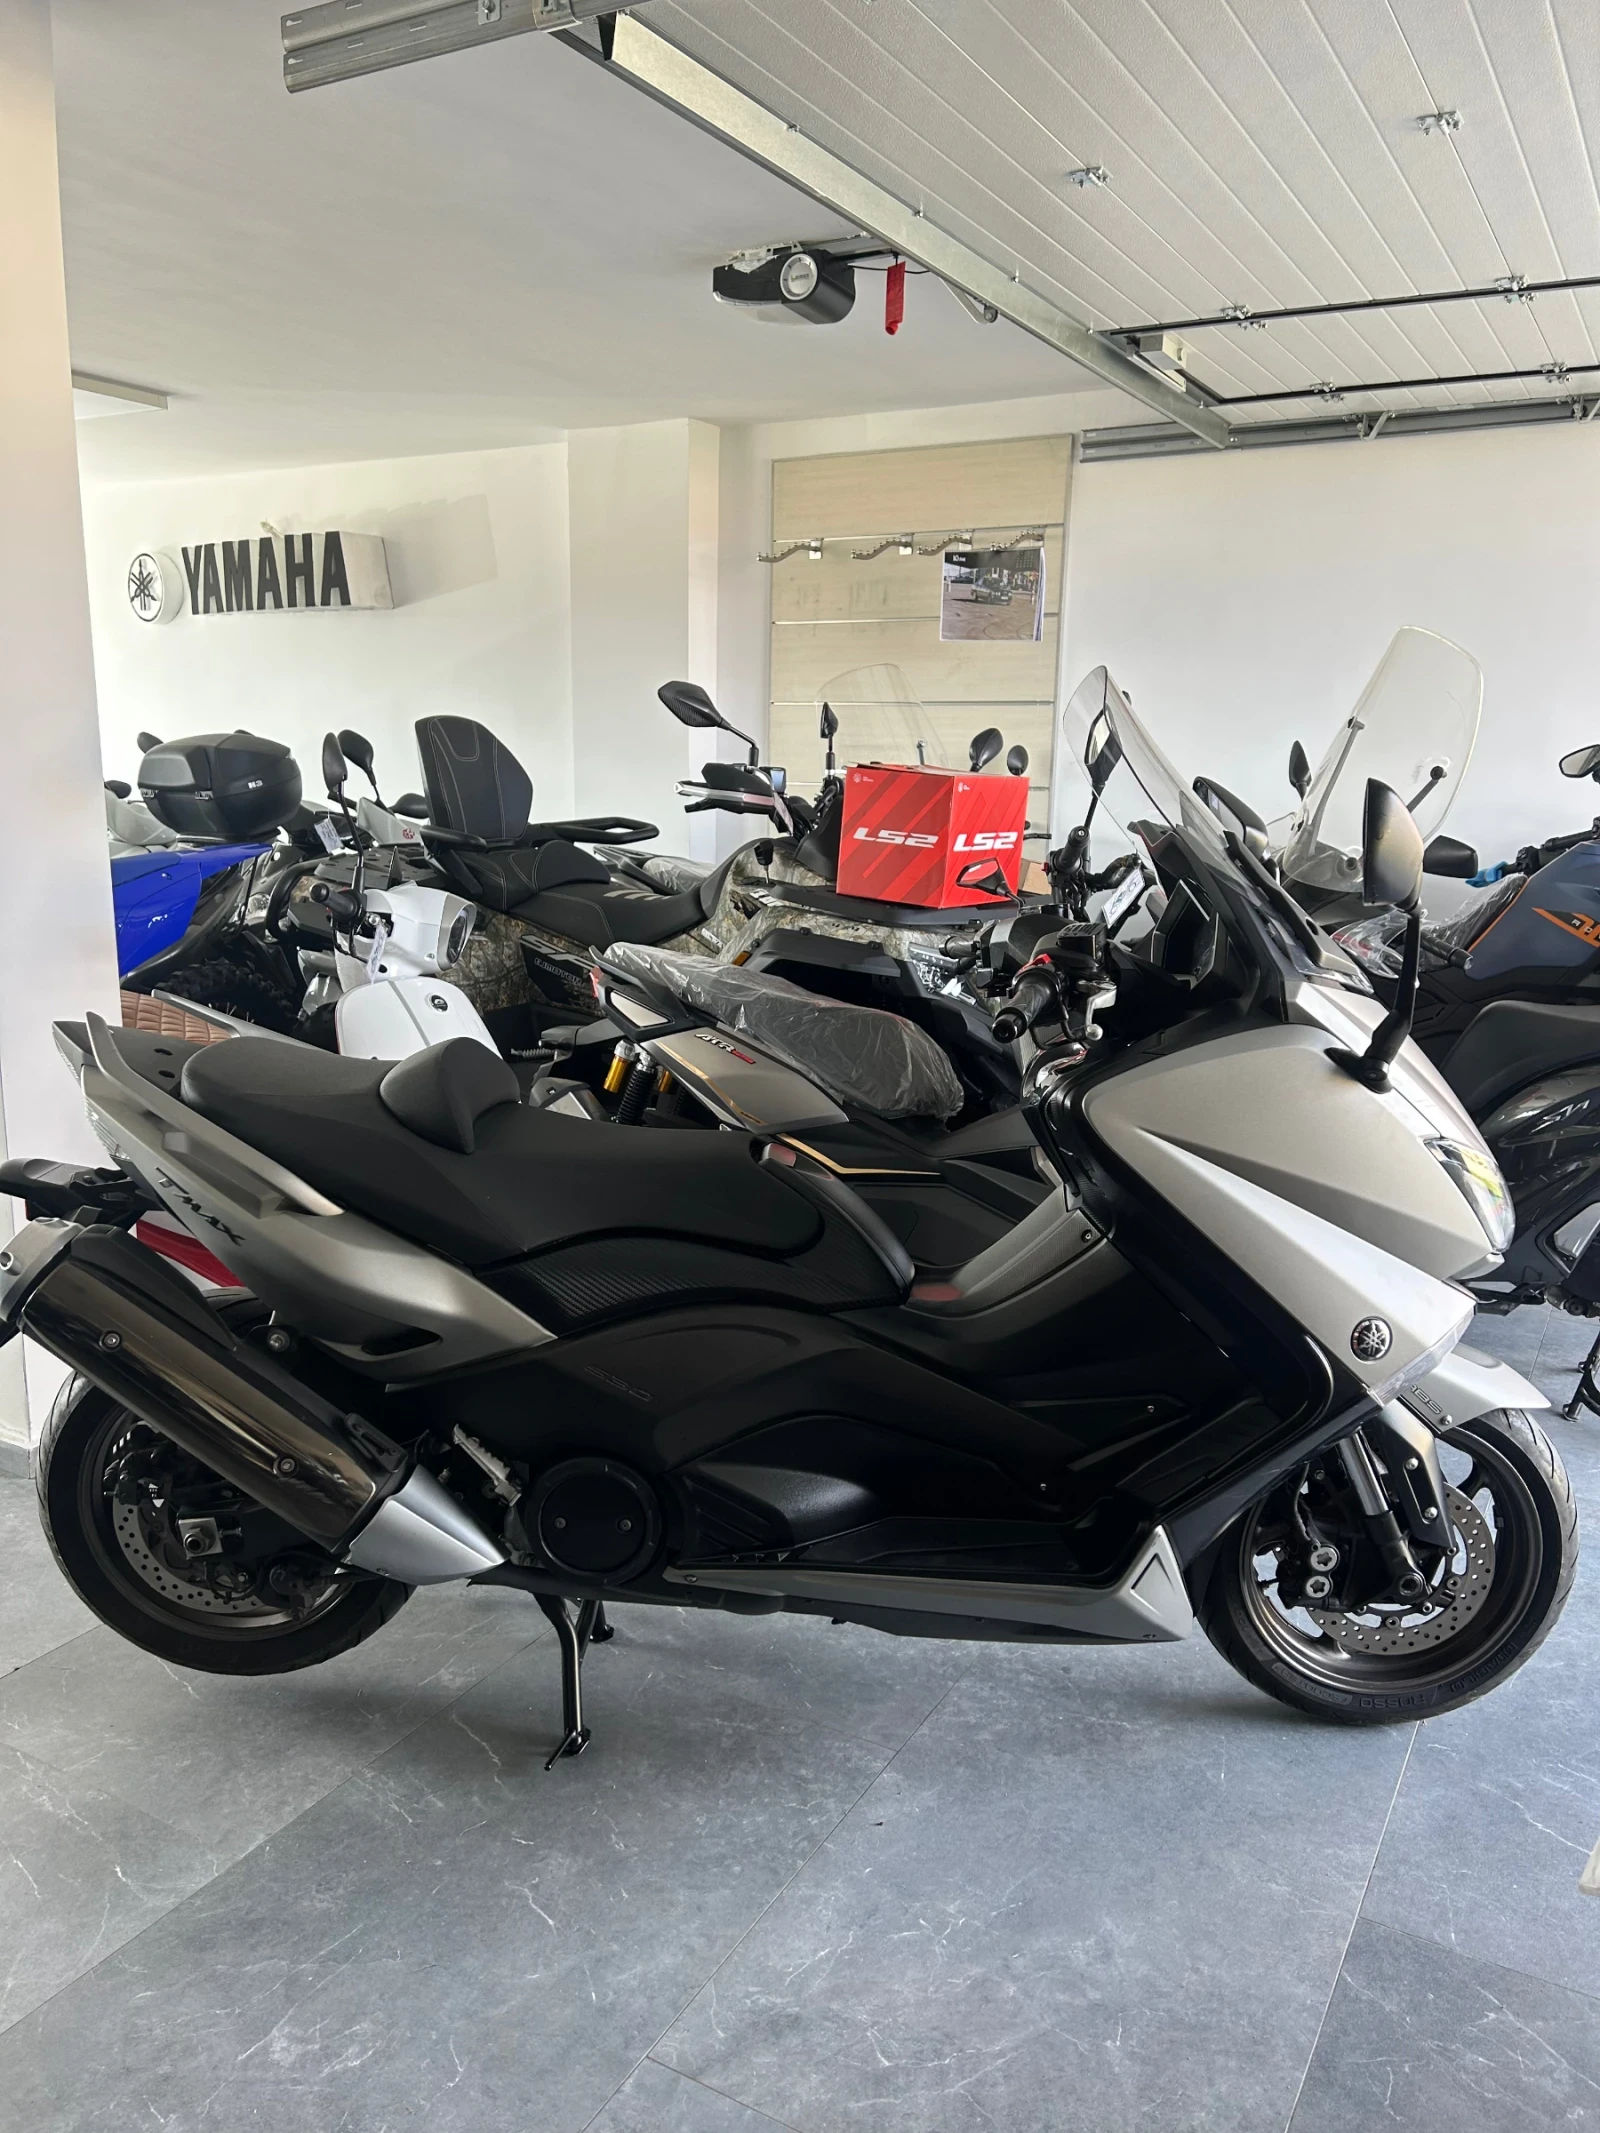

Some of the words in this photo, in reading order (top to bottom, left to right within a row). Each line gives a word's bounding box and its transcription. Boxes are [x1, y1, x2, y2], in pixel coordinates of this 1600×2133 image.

[181, 530, 351, 616] YAMAHA
[853, 827, 939, 849] LS2
[953, 831, 1018, 852] LS2
[155, 1167, 247, 1247] TMAX
